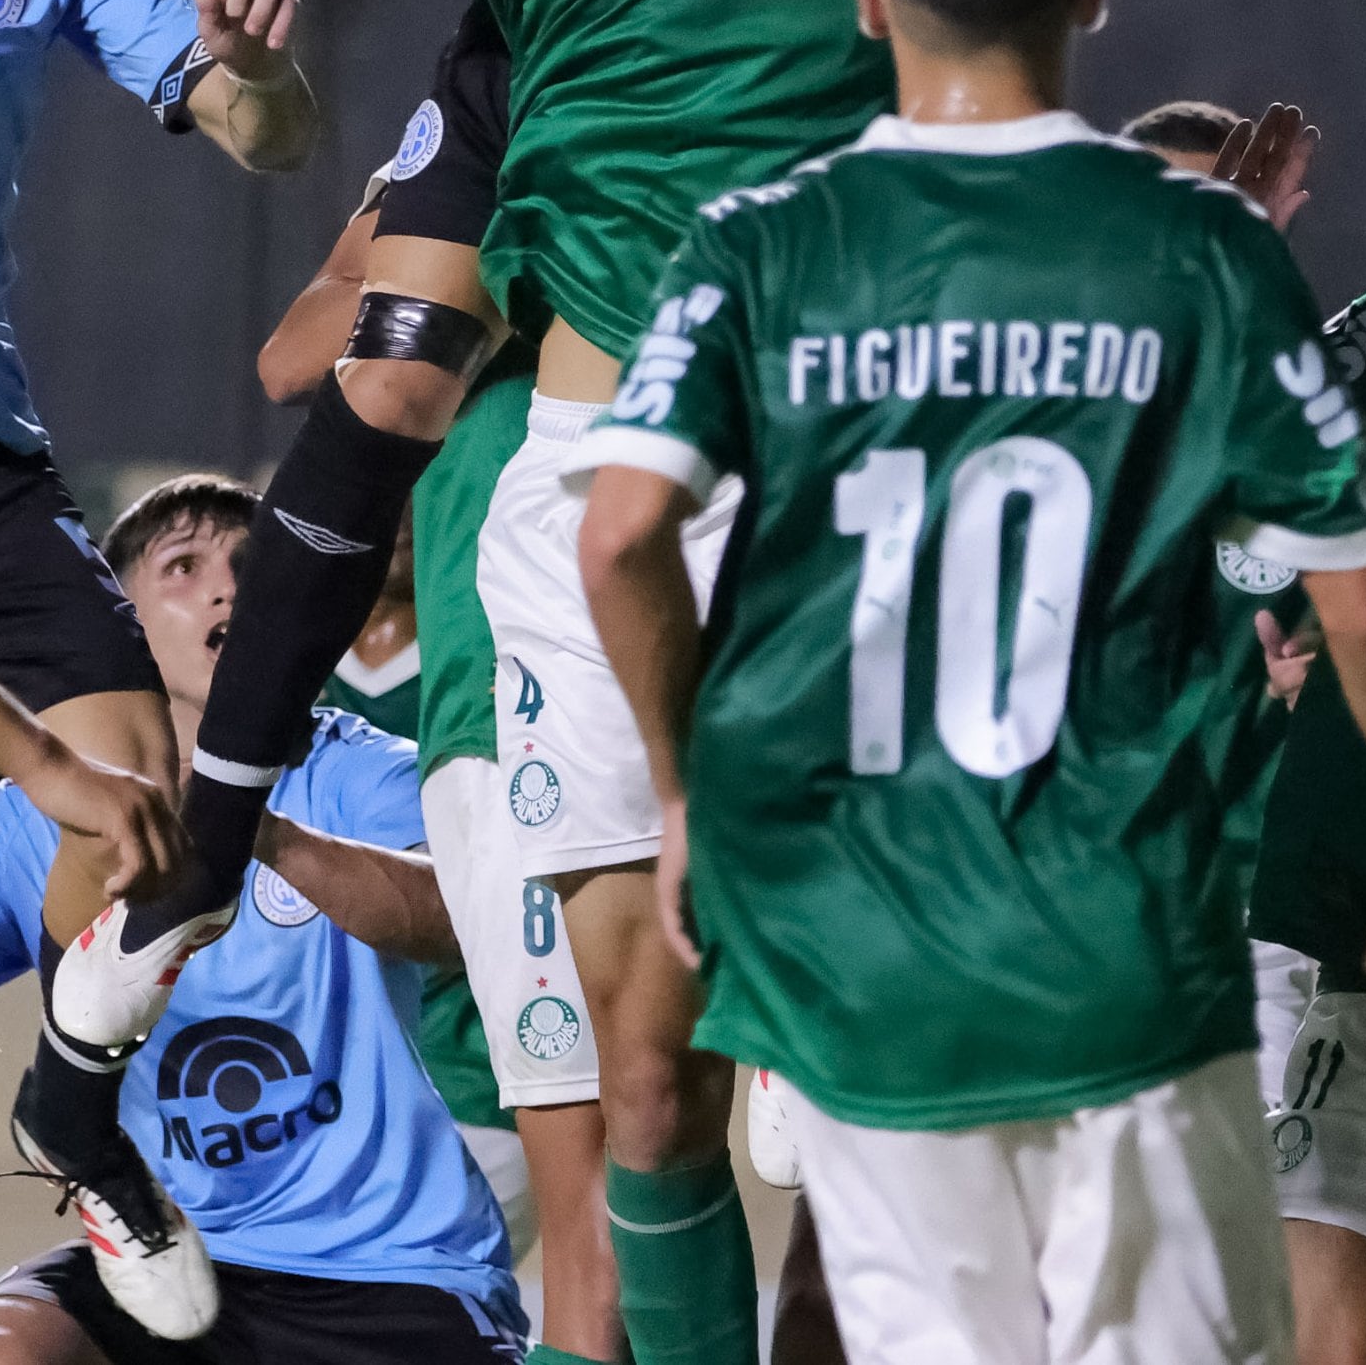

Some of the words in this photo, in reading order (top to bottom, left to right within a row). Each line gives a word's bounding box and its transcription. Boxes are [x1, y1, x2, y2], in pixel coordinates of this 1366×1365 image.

[788, 319, 1163, 405] FIGUEIREDO
[834, 435, 1093, 778] 10
[512, 656, 546, 725] 4
[511, 784, 560, 825] PALMEIRAS
[522, 876, 556, 958] 8
[519, 1020, 579, 1059] PALMEIRAS
[1292, 1038, 1345, 1110] 11
[157, 1078, 343, 1169] Macro
